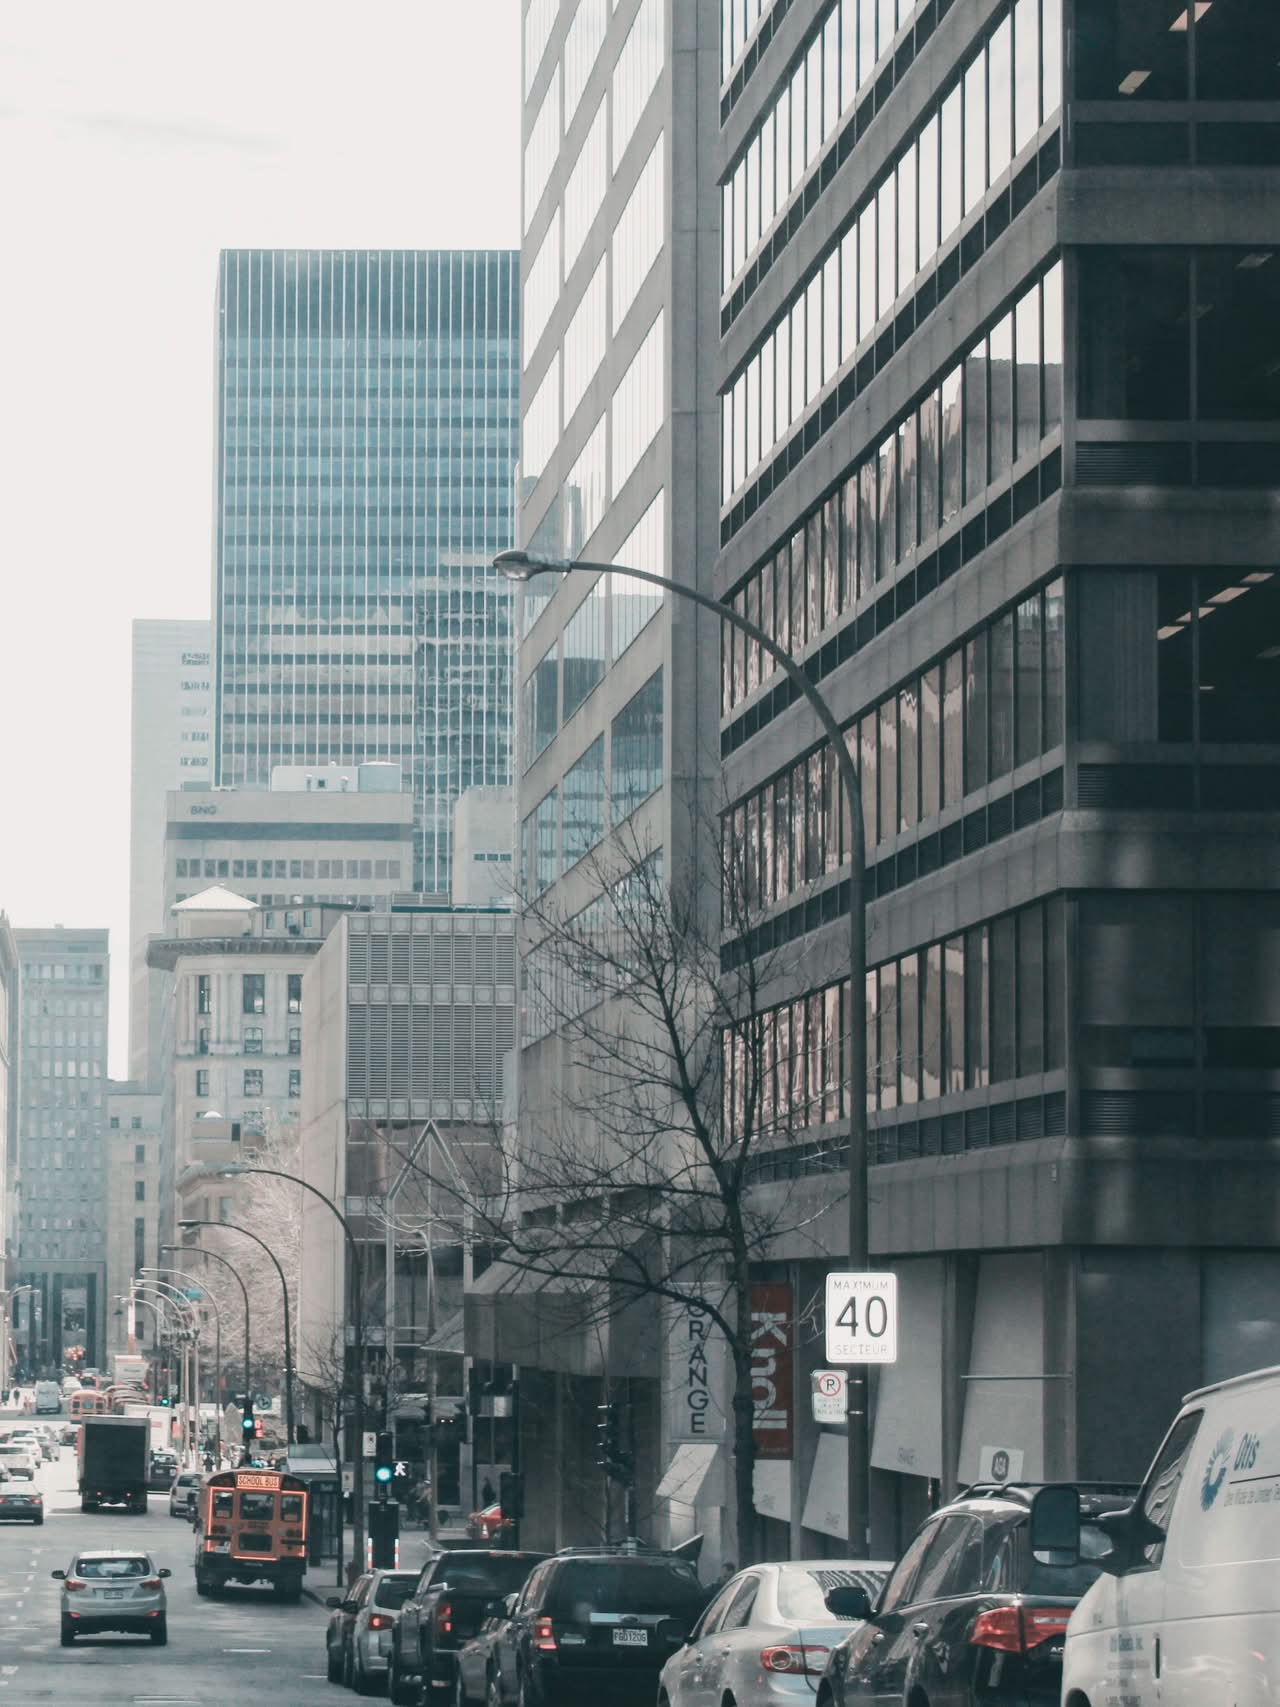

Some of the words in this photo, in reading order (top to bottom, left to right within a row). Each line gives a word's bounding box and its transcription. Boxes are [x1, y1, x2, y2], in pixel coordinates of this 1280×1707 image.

[834, 1281, 888, 1289] MAXIMUM
[835, 1296, 888, 1338] 40
[835, 1344, 888, 1356] SECTEUR
[751, 1312, 787, 1429] Knoll
[238, 1475, 263, 1486] SCHOOL
[265, 1477, 277, 1487] BUS
